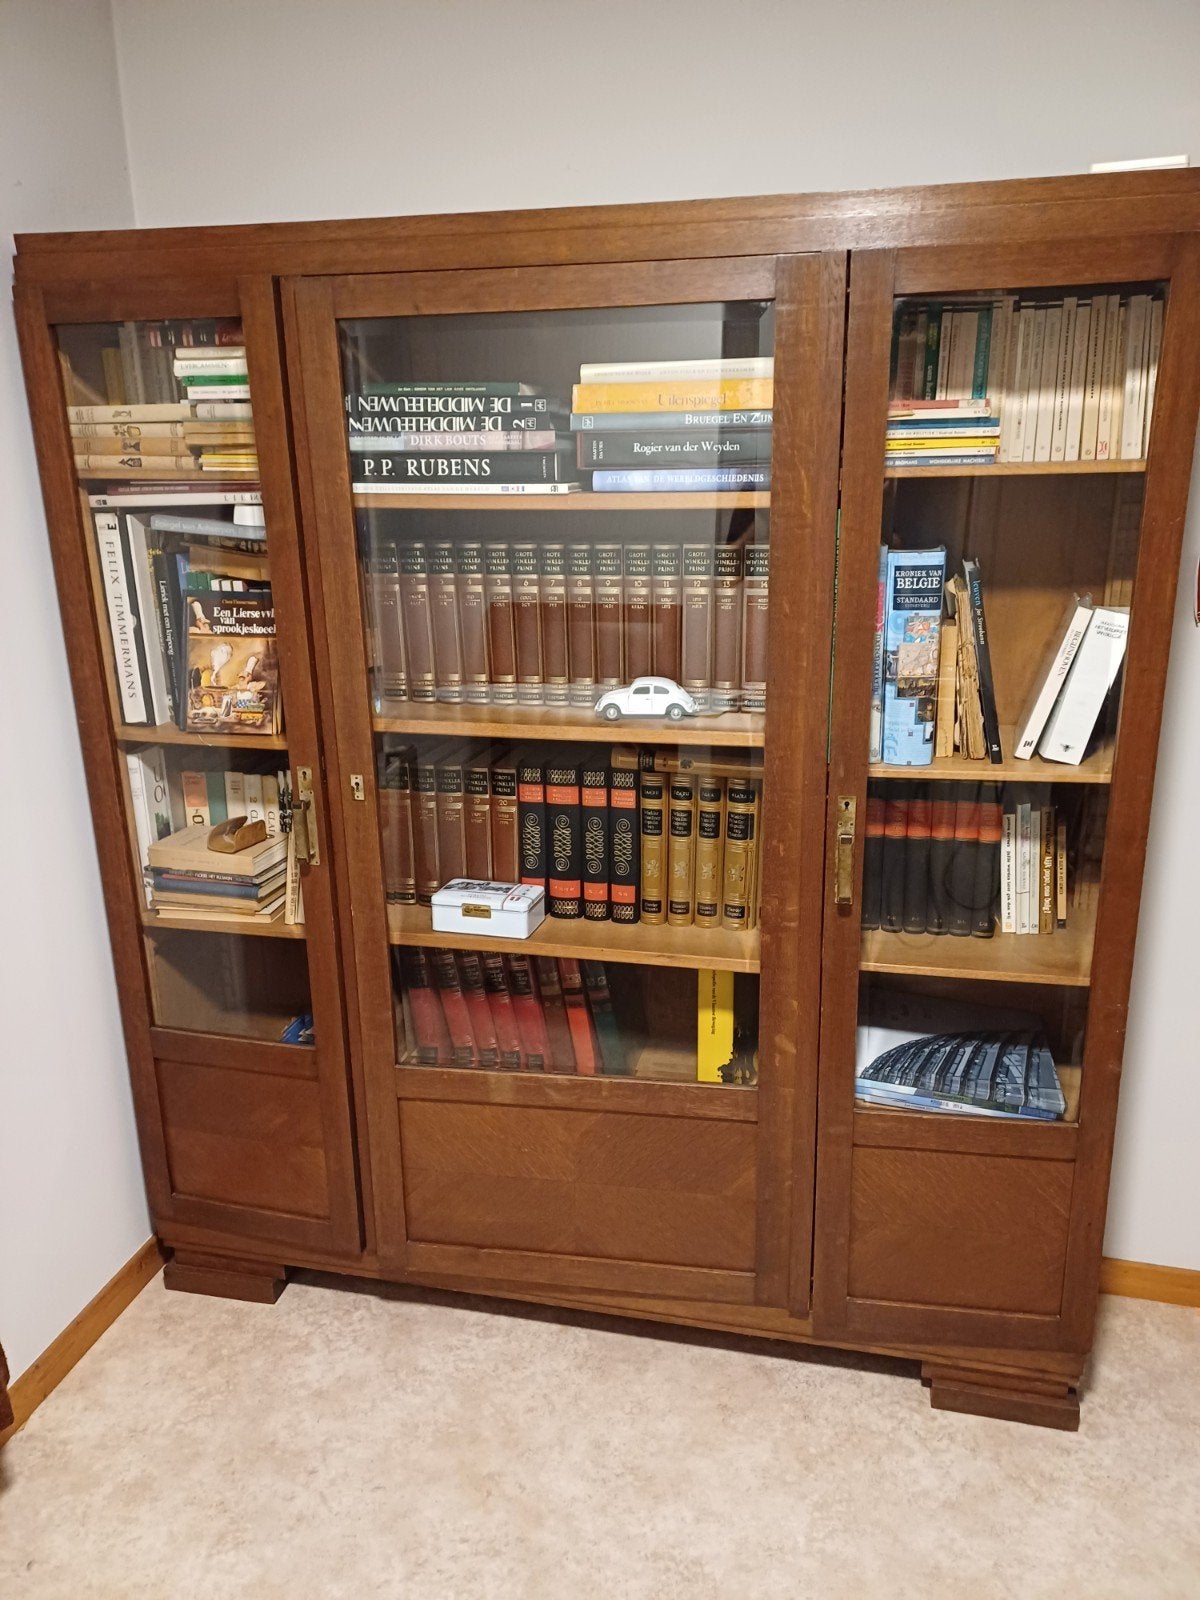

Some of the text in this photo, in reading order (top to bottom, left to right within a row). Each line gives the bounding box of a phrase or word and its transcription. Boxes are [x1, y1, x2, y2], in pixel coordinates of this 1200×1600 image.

[358, 396, 512, 412] DE MIDDELEEUWEN
[481, 416, 502, 431] DE
[685, 413, 729, 425] BRUEGEL
[410, 435, 441, 446] DIRK
[447, 434, 486, 446] BOUTS
[633, 440, 740, 455] Rogier van der Weyden
[363, 458, 491, 476] P.P. RUBENS
[929, 569, 942, 577] VAN
[896, 596, 939, 604] STANDAARD
[213, 606, 231, 617] Een
[233, 607, 260, 619] Lierse
[105, 541, 120, 585] FELIX
[113, 593, 137, 699] TIMMERMANS
[220, 617, 236, 625] van
